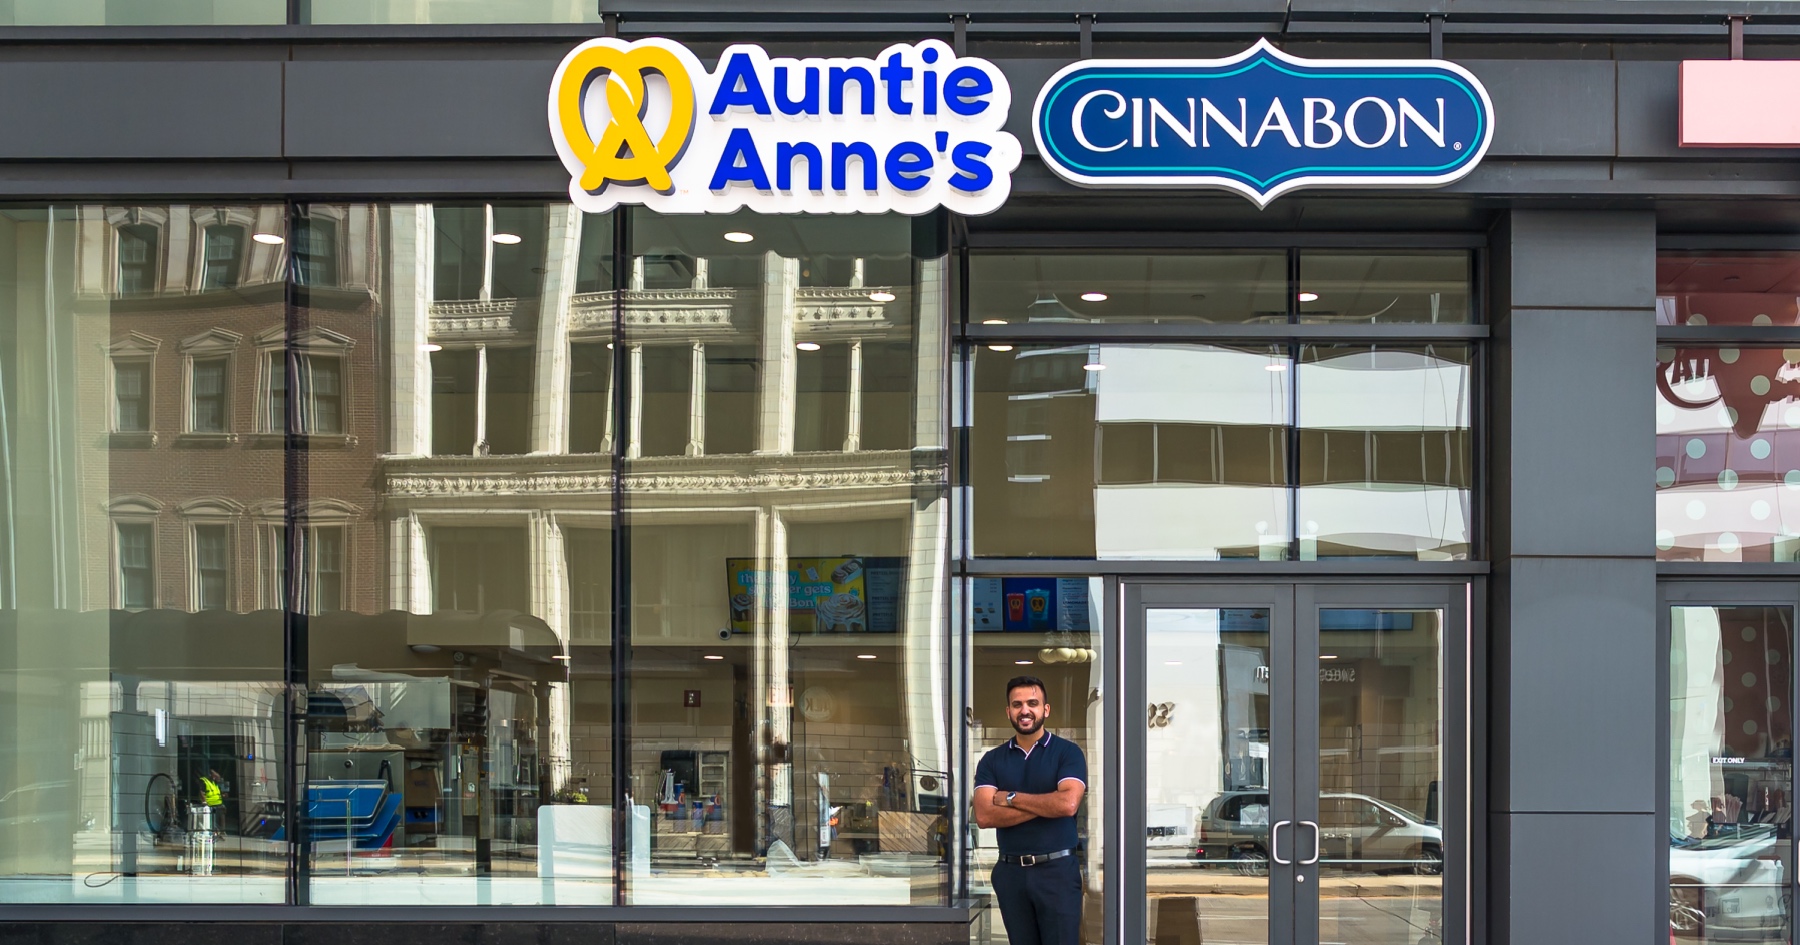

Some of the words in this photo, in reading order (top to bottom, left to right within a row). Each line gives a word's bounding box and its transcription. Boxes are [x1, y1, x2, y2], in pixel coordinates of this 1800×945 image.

[709, 47, 994, 117] Auntie
[1072, 89, 1446, 153] CINNABON
[709, 128, 994, 193] Anne's
[804, 584, 832, 596] gets
